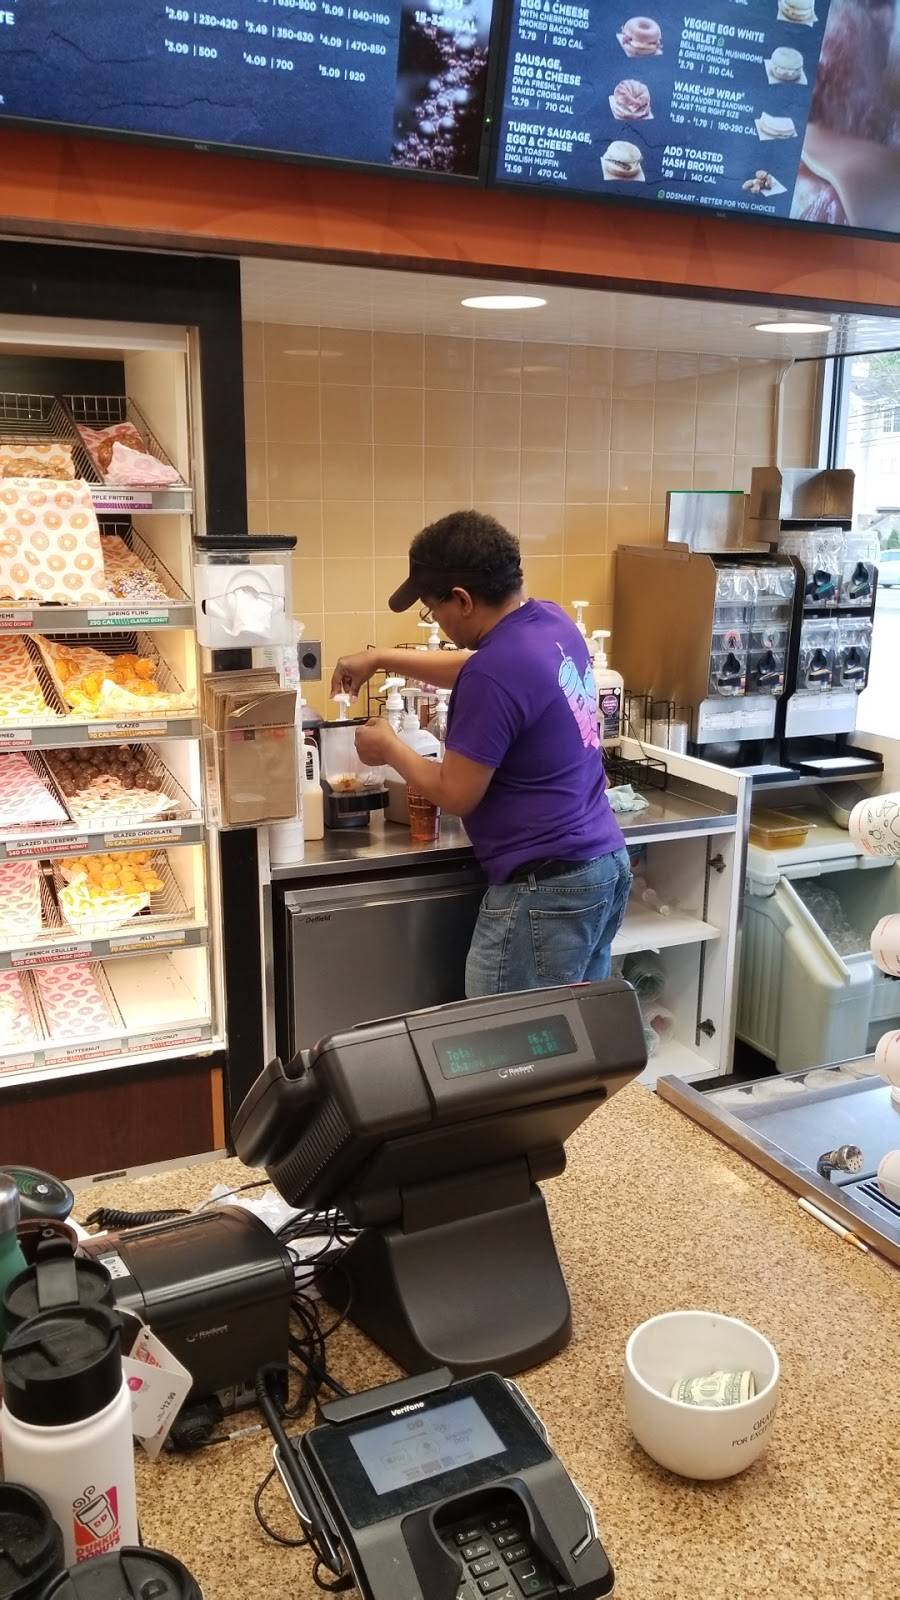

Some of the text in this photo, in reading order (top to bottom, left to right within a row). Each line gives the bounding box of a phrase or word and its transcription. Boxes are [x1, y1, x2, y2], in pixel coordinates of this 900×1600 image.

[520, 8, 589, 29] WITH CHERRYWOOD
[552, 3, 590, 20] CHEESE
[454, 19, 478, 34] CAL
[519, 18, 574, 35] SMOKED BACON
[684, 16, 765, 43] VEGGIE EGG WHITE
[198, 14, 238, 31] 230-420
[277, 27, 314, 43] 350-630
[351, 40, 386, 56] 470-850
[552, 36, 567, 46] 520
[568, 39, 583, 50] CAL
[682, 29, 717, 45] OMELET
[680, 40, 695, 50] BELL
[725, 49, 763, 64] MUSHROOMS
[684, 50, 705, 61] GREEN
[706, 55, 730, 66] ONIONS
[198, 47, 218, 59] 500
[276, 59, 294, 72] 700
[349, 71, 366, 83] 920
[515, 52, 562, 71] SAUSAGE,
[514, 65, 581, 86] EGG & CHEESE
[708, 66, 720, 75] 310
[720, 68, 734, 78] CAL
[513, 76, 561, 91] ON A FRESHLY
[674, 80, 715, 97] WAKE-UP
[512, 85, 574, 103] BAKED CROISSANT
[545, 102, 558, 112] 710
[559, 104, 574, 115] CAL
[671, 101, 739, 119] IN JUST THE RIGHT SIZE
[672, 92, 753, 113] YOUR FAVORITE SANDWICH
[508, 121, 592, 145] TURKEY SAUSAGE,
[744, 127, 757, 136] CAL
[506, 133, 573, 152] EGG & CHEESE
[505, 144, 555, 158] ON A TOASTED
[663, 145, 723, 163] ADD TOASTED
[504, 153, 559, 168] ENGLISH MUFFIN
[662, 156, 725, 175] HASH BROWNS
[537, 169, 552, 178] 470
[553, 171, 567, 180] CAL
[690, 173, 702, 182] 140
[703, 174, 716, 184] CAL
[700, 196, 723, 206] BETTER
[723, 199, 736, 208] FOR
[737, 200, 749, 210] YOU
[750, 203, 776, 213] CHOICES
[137, 829, 173, 837] CHOCOLATE
[16, 836, 79, 848] GLAZED BLUEBERRY
[25, 946, 78, 957] FRENCH CRULLER
[151, 1033, 179, 1042] COCONUT
[66, 1045, 100, 1055] BUTTERNUT
[390, 1401, 425, 1417] Verifone
